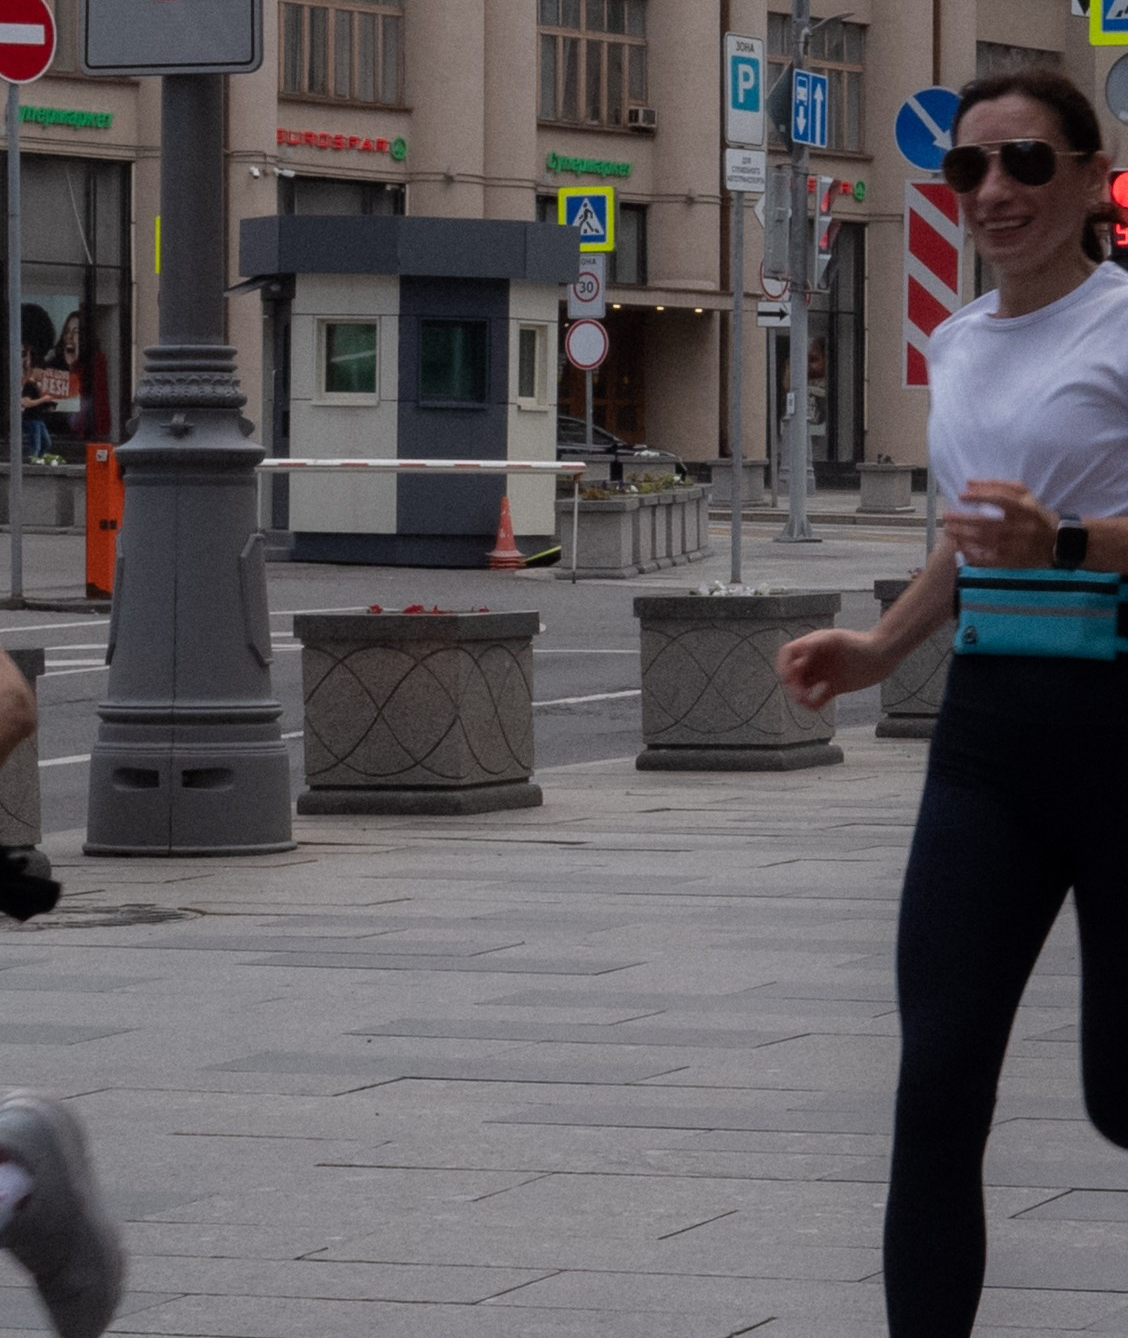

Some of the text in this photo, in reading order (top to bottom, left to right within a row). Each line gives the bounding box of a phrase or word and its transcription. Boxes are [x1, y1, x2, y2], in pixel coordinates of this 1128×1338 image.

[736, 42, 754, 52] ЗОНА
[277, 128, 389, 152] EUROSPAR
[581, 258, 597, 266] ОНА
[579, 281, 594, 294] 30
